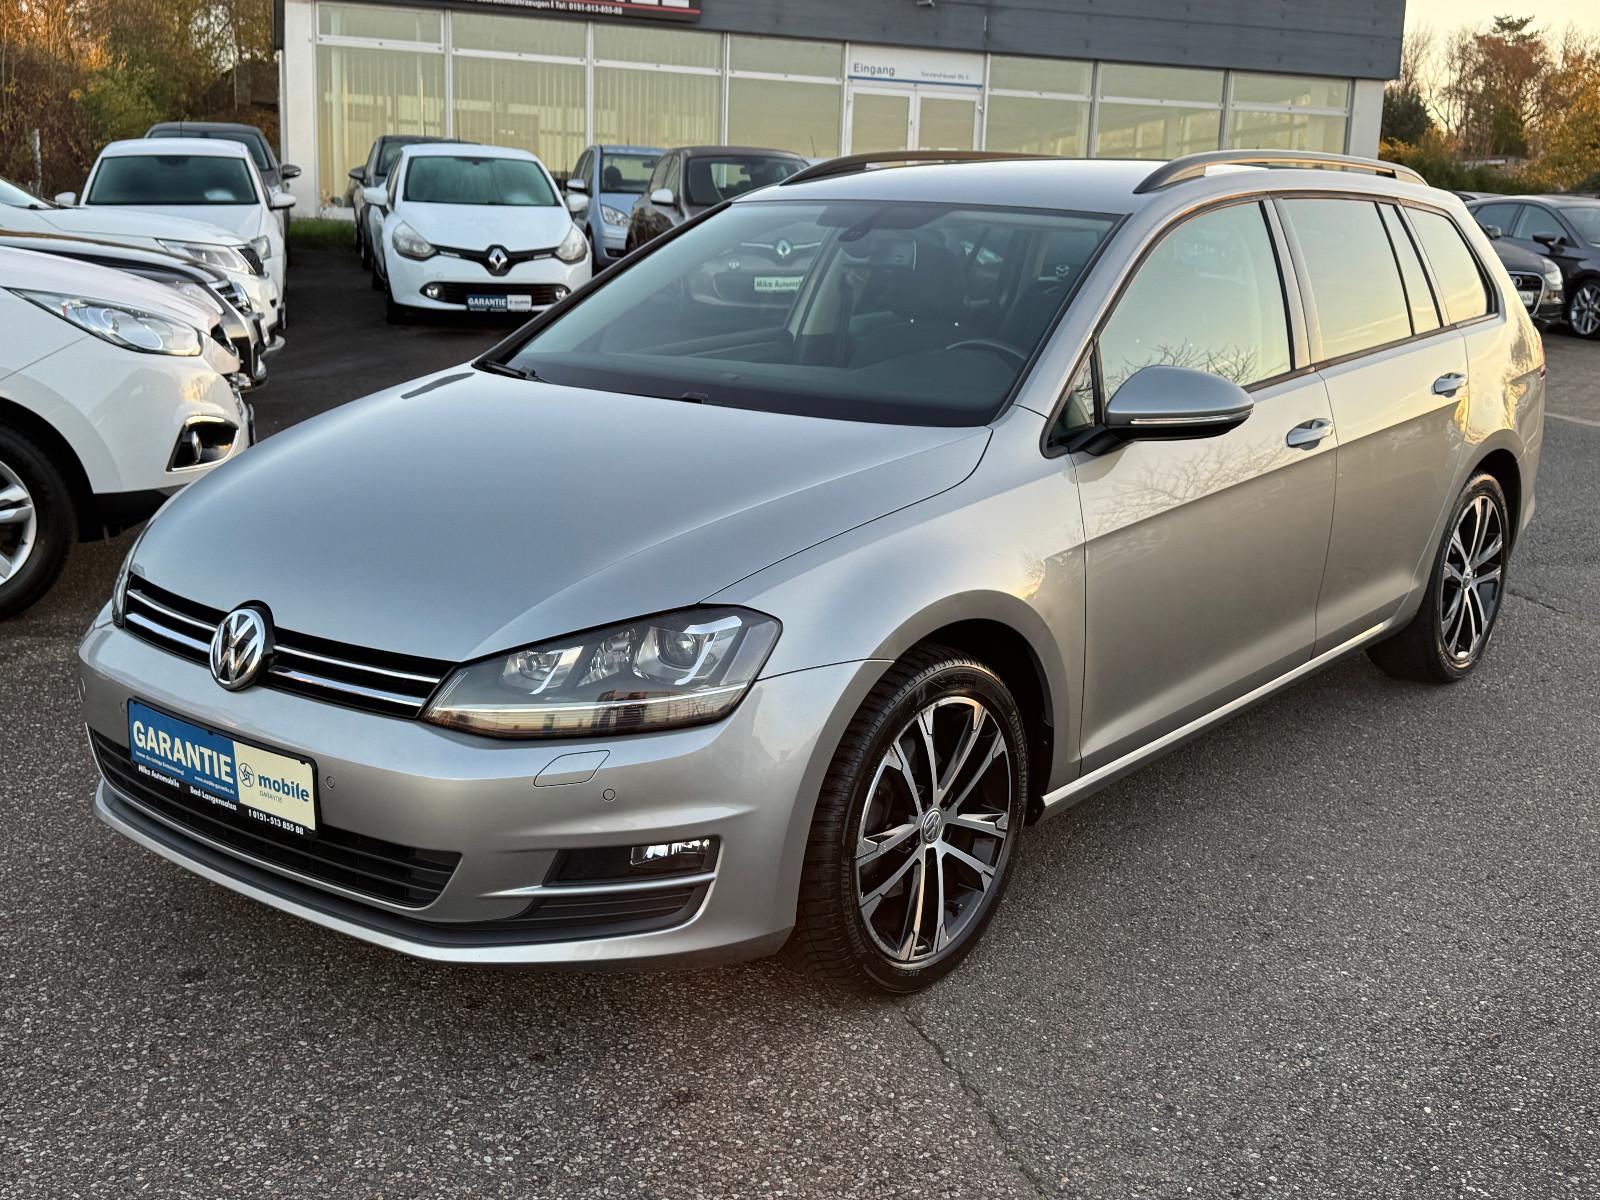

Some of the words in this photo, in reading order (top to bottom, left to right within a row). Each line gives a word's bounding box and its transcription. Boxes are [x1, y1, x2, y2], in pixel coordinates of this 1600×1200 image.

[853, 63, 896, 77] Eingang
[467, 297, 507, 307] GARANTIE
[133, 720, 234, 785] GARANTIE
[151, 769, 180, 788] Automobile
[258, 774, 310, 802] mobile
[189, 786, 201, 797] Bad
[252, 810, 281, 828] 0151-513
[282, 821, 294, 832] 855
[295, 825, 304, 836] 88
